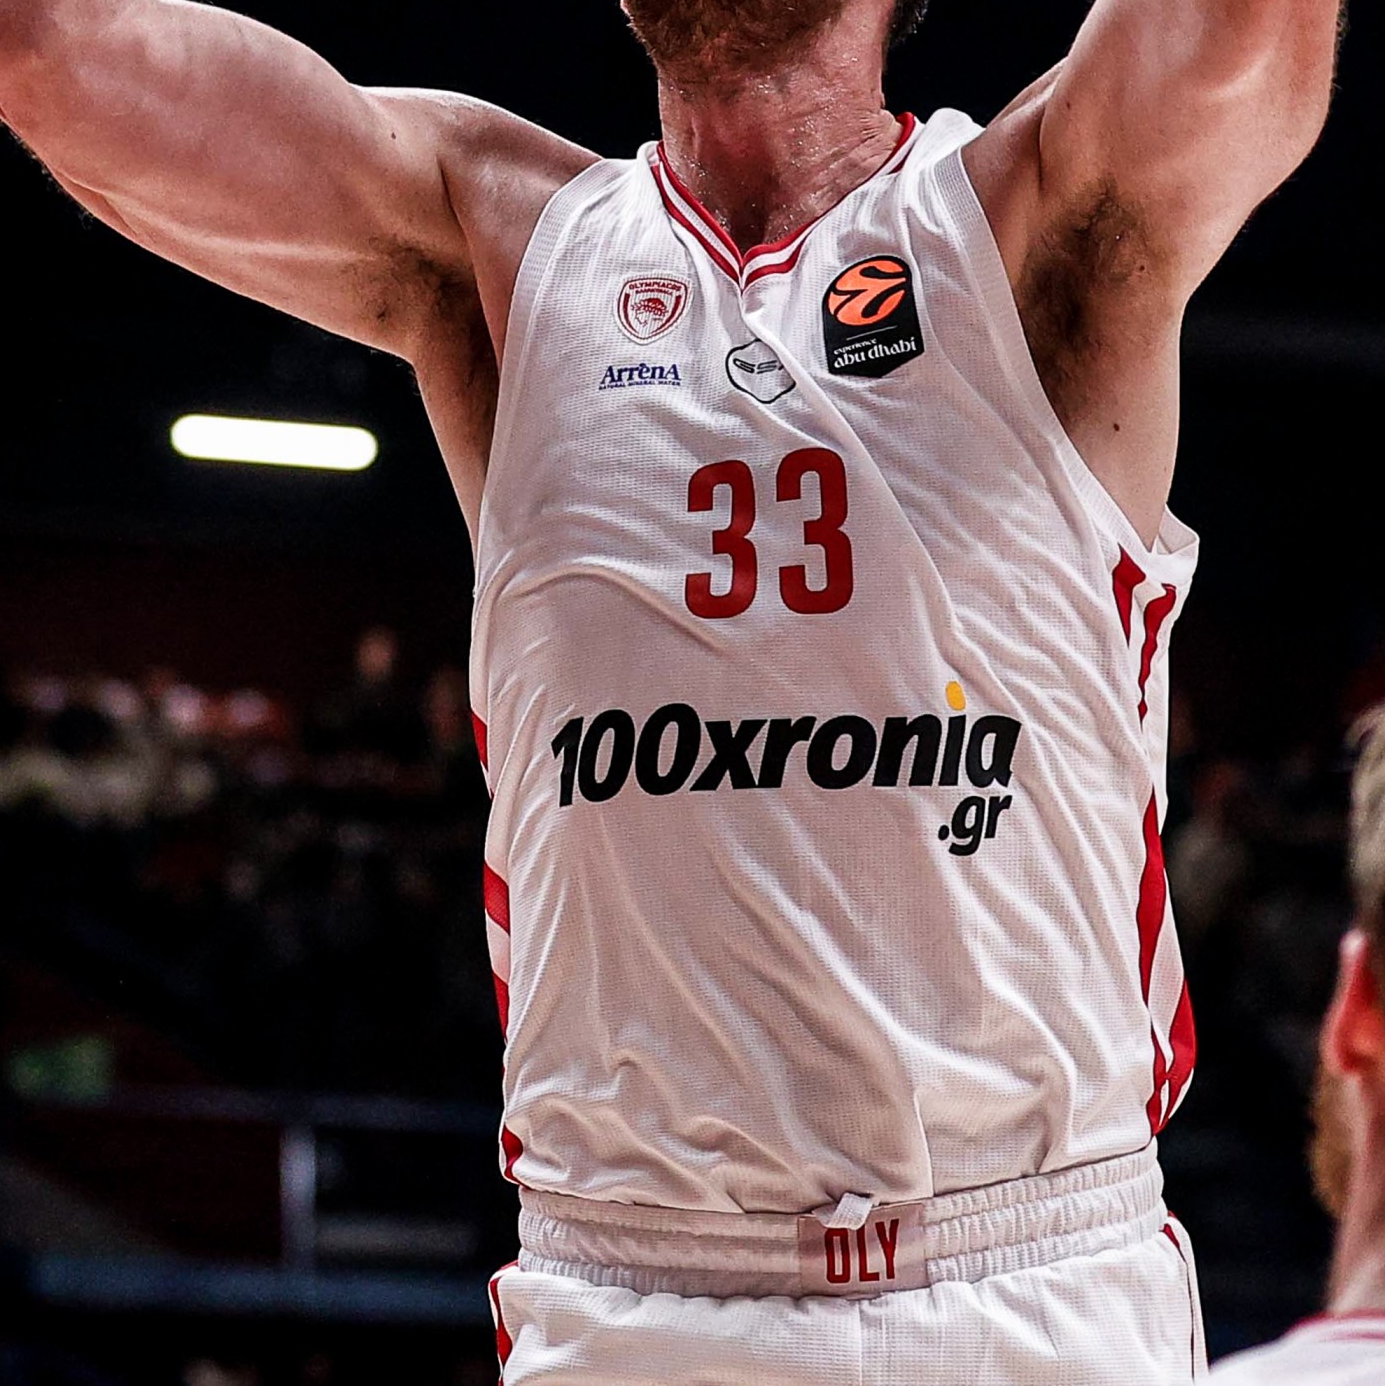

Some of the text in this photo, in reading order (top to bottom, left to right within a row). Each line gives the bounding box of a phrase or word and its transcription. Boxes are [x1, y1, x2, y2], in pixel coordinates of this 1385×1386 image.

[732, 358, 785, 374] GS
[833, 336, 918, 369] abu dhabi
[684, 447, 854, 620] 33
[551, 680, 1022, 808] 100xronia
[937, 794, 1013, 857] .gr
[823, 1218, 900, 1284] OLY
